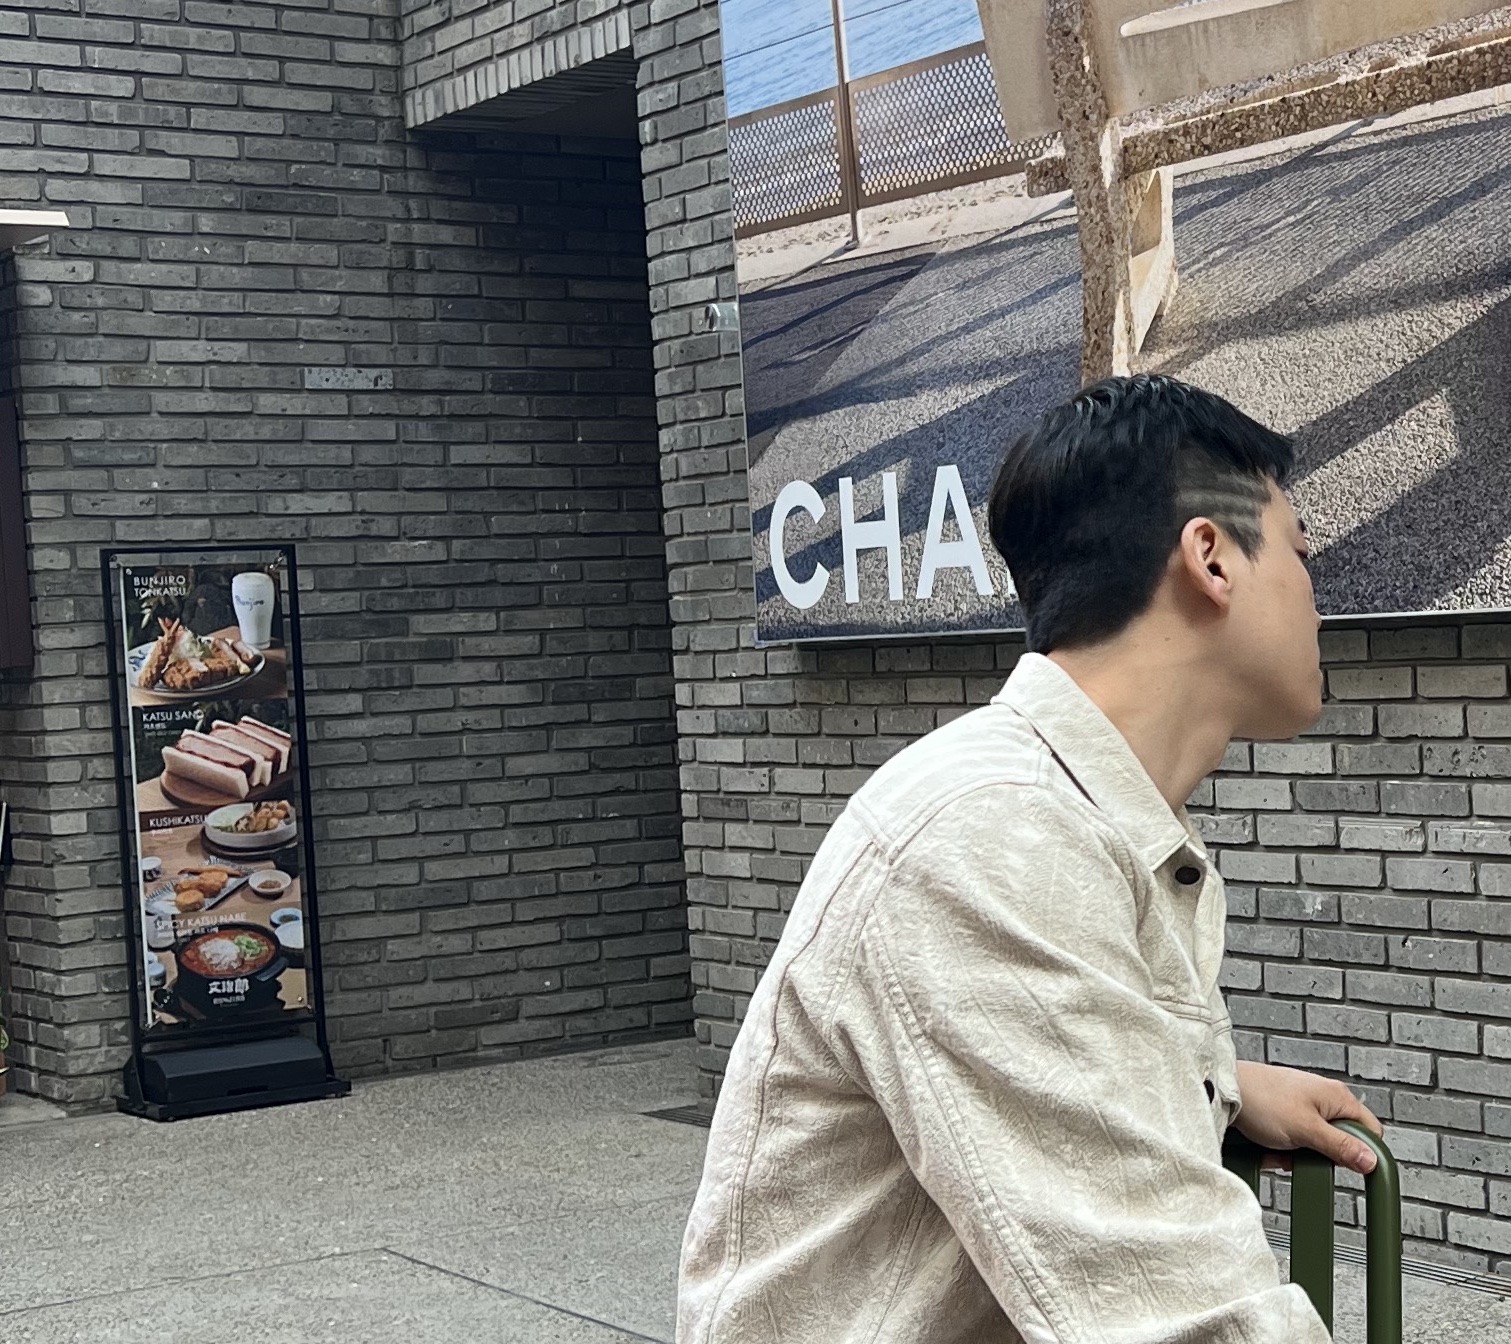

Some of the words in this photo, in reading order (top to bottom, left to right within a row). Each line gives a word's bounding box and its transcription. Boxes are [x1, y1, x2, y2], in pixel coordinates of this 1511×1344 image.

[768, 464, 1018, 610] CHA
[133, 575, 186, 587] BUNJIRO
[133, 586, 187, 598] TONKATSU
[142, 711, 173, 722] KATSU
[149, 814, 207, 828] KUSHIKATSU
[187, 914, 218, 927] KATSU
